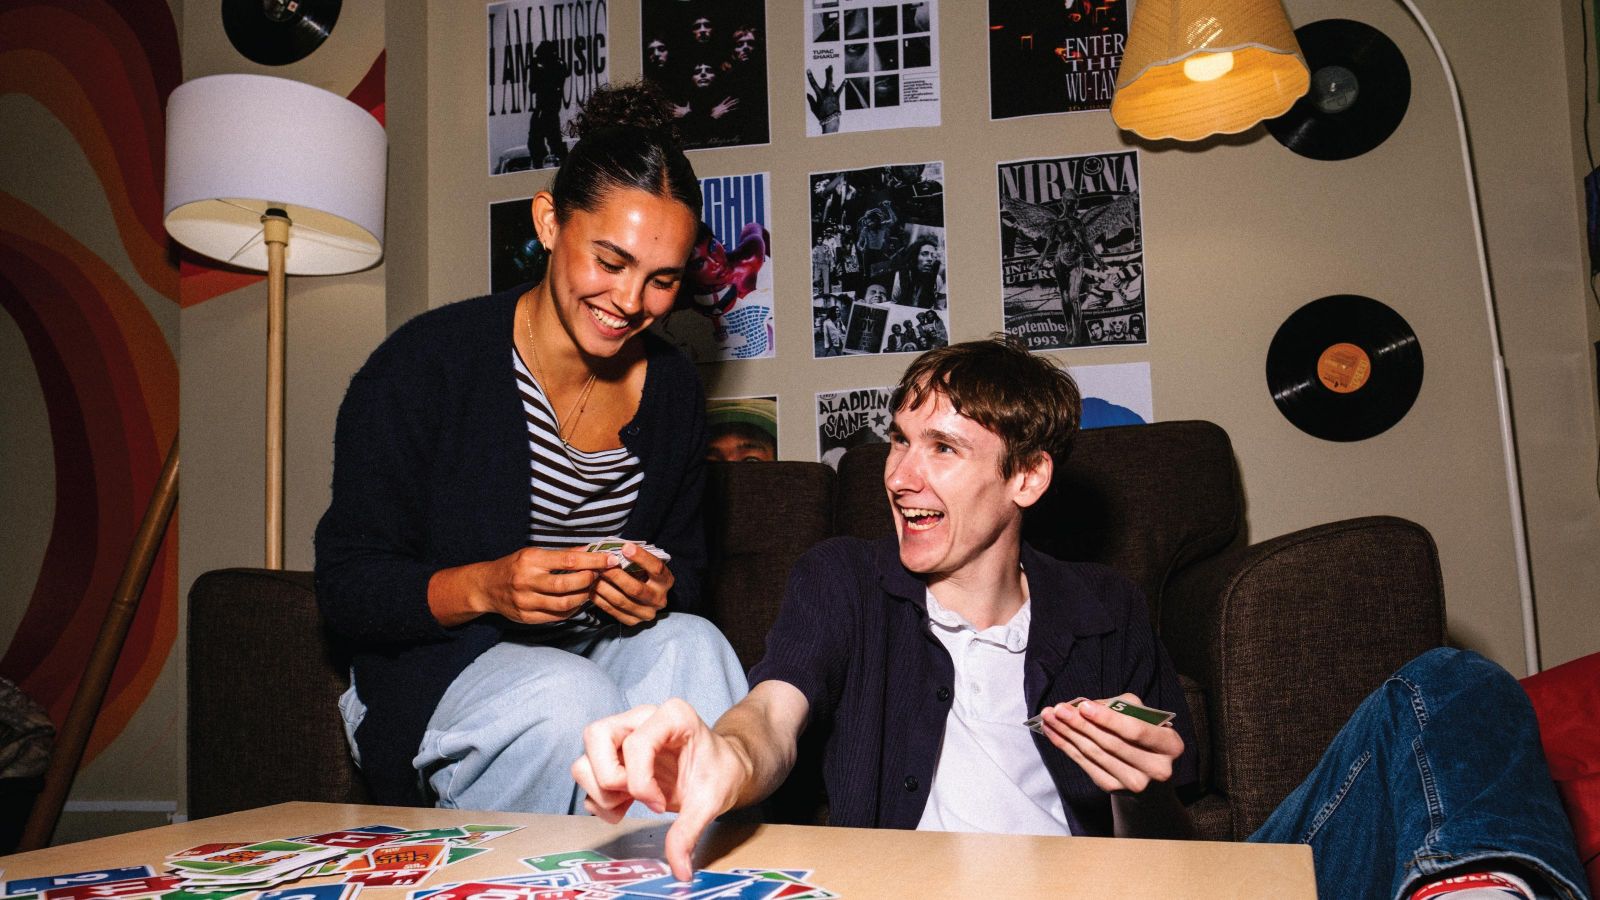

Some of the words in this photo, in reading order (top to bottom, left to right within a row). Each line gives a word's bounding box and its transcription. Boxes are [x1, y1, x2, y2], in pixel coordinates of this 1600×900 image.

[1065, 33, 1125, 59] ENTER
[1065, 55, 1123, 72] THE
[1065, 69, 1117, 103] WU-TAN
[999, 154, 1138, 204] NIRVANA
[1005, 264, 1022, 276] IN
[1027, 336, 1060, 347] 1993
[819, 389, 890, 415] ALADDIN
[825, 411, 870, 440] SANE
[1112, 702, 1128, 712] 5
